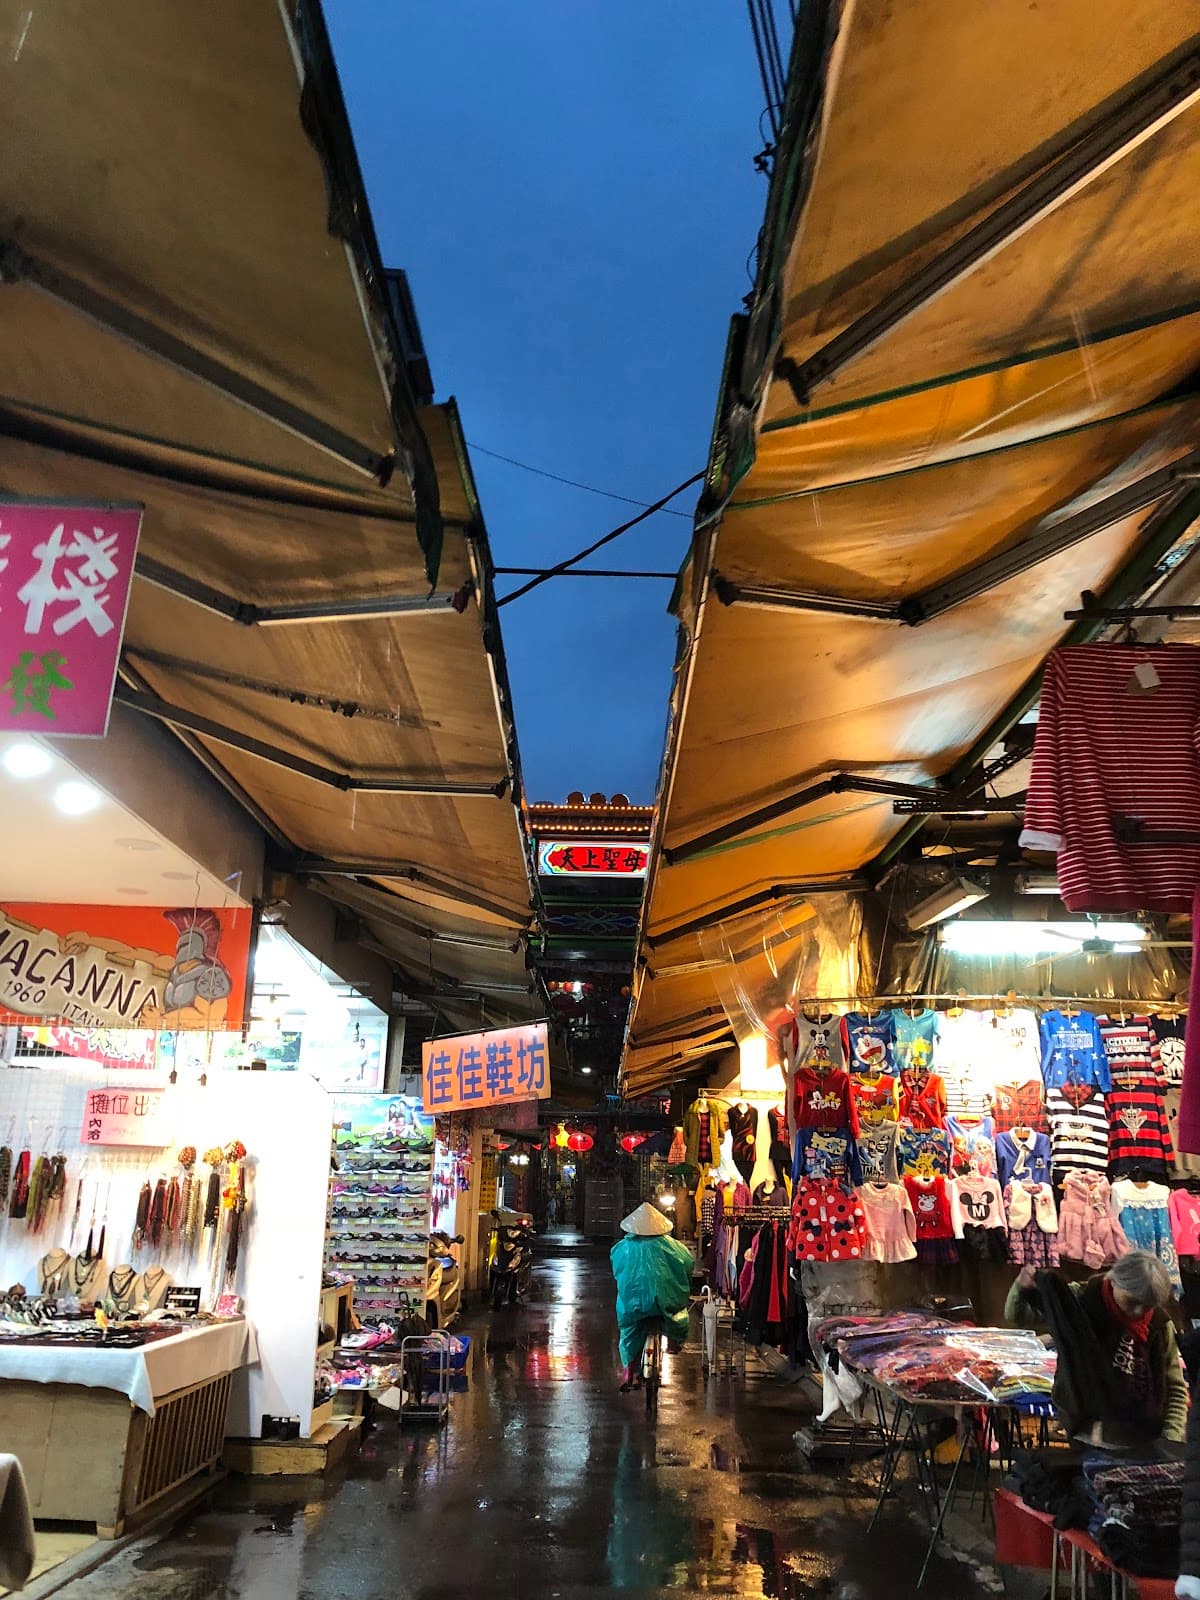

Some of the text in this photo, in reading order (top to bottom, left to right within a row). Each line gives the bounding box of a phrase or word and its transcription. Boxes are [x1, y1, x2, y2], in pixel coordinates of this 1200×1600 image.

[0, 520, 119, 637] 棧
[559, 848, 644, 872] 天上聖母
[0, 928, 160, 1020] ACANNA
[4, 980, 46, 1004] 1960
[426, 1034, 545, 1106] 佳佳鞋坊
[89, 1093, 158, 1117] 攤位出
[808, 1100, 841, 1111] MICKEY
[971, 1204, 986, 1218] M
